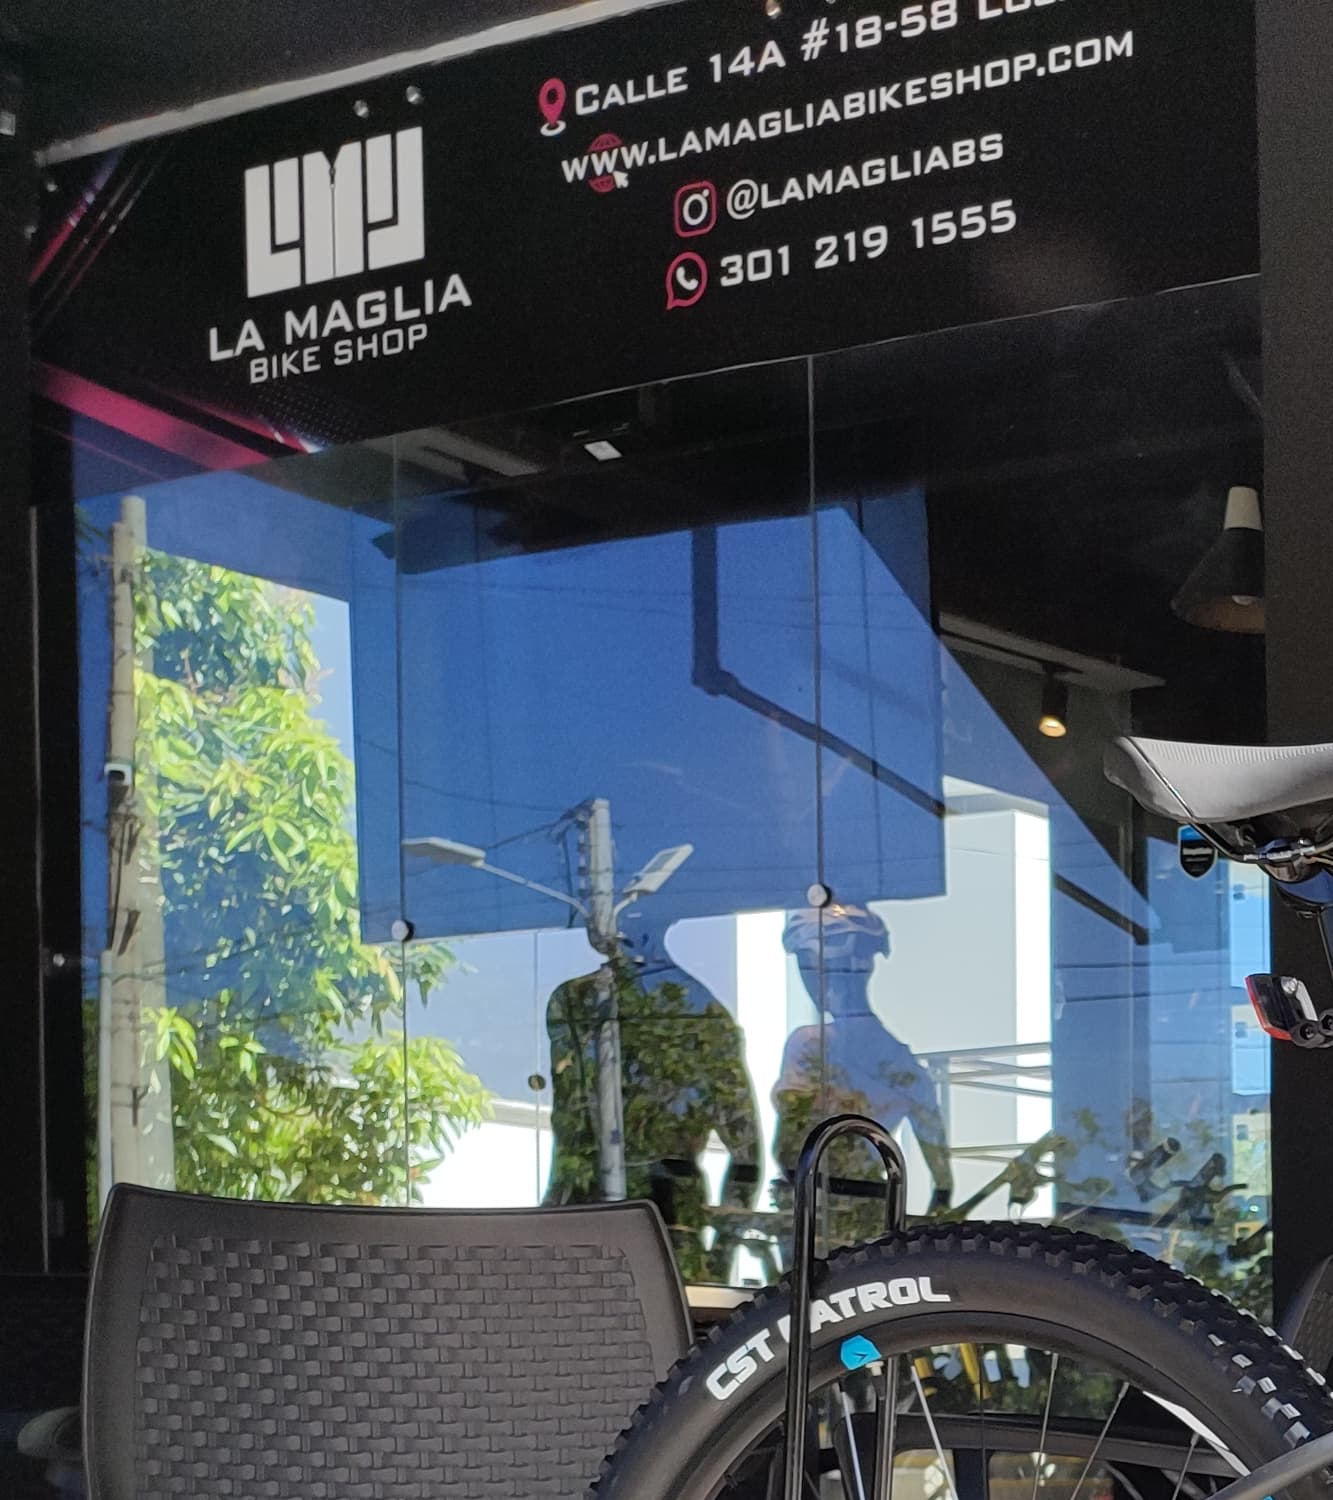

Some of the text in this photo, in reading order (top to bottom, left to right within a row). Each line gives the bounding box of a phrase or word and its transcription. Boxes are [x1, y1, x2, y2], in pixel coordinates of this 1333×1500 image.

[575, 67, 688, 117] CALLE
[709, 39, 786, 85] 14A
[801, 0, 958, 62] #18-58
[726, 132, 1005, 220] @LAMAGLIABS
[720, 200, 1018, 287] 301 219 1555
[210, 274, 472, 361] LA MAGLIA
[250, 323, 428, 383] BIKE SHOP
[705, 1330, 775, 1402] CST
